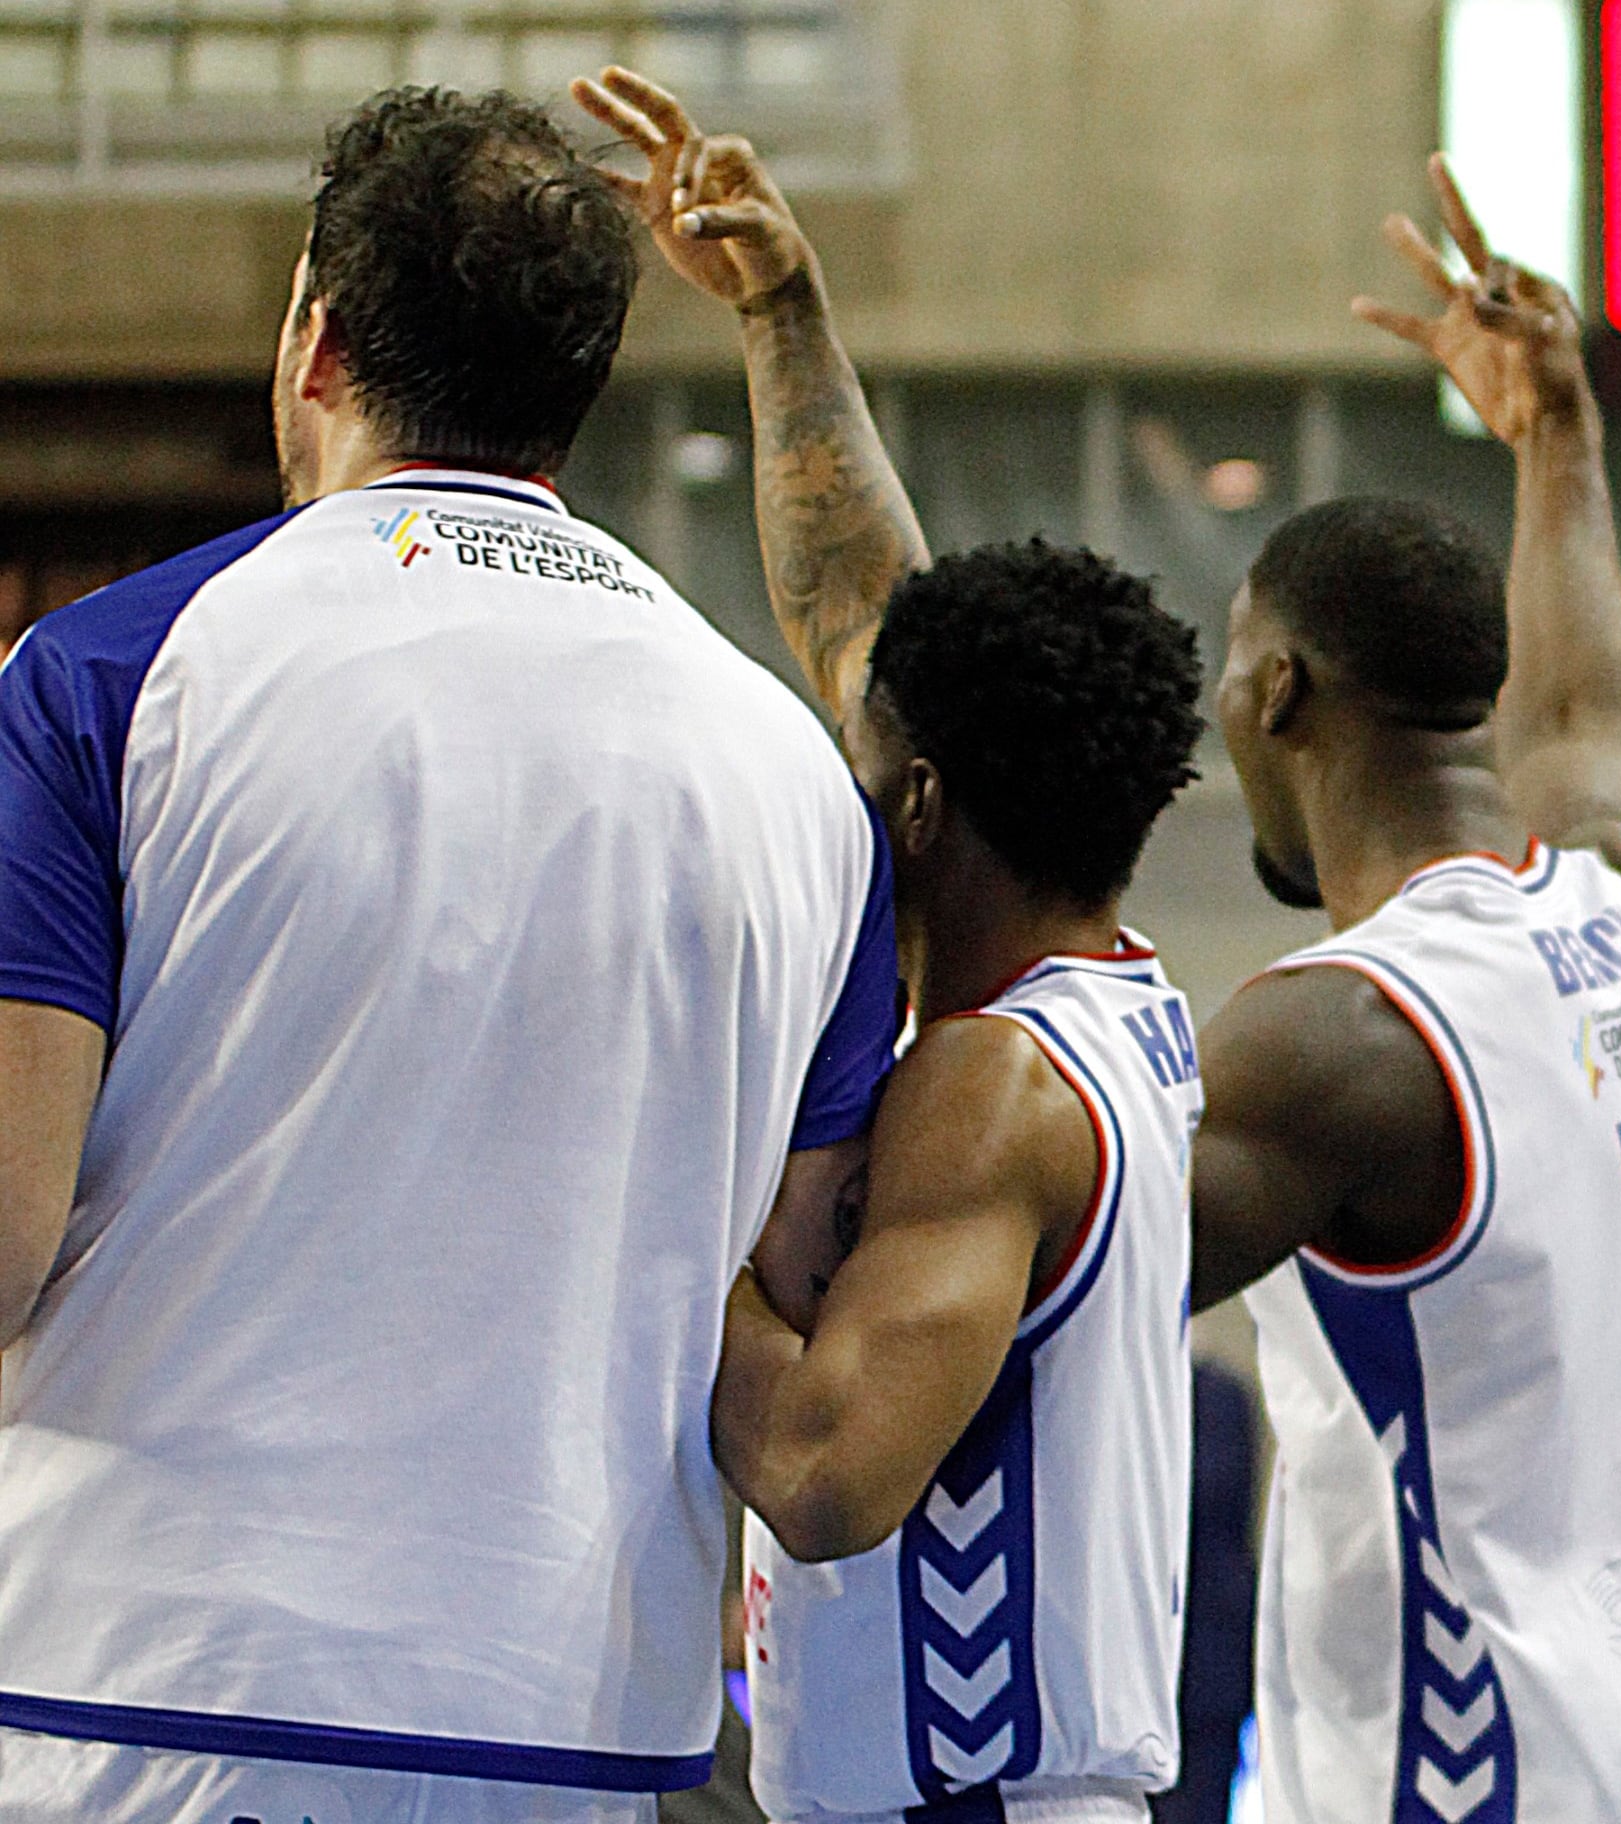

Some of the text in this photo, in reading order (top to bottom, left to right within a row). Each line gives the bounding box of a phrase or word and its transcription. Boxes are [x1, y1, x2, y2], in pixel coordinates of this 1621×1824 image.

[435, 522, 624, 577] COMUNITAT
[456, 542, 656, 603] DE L'ESPORT
